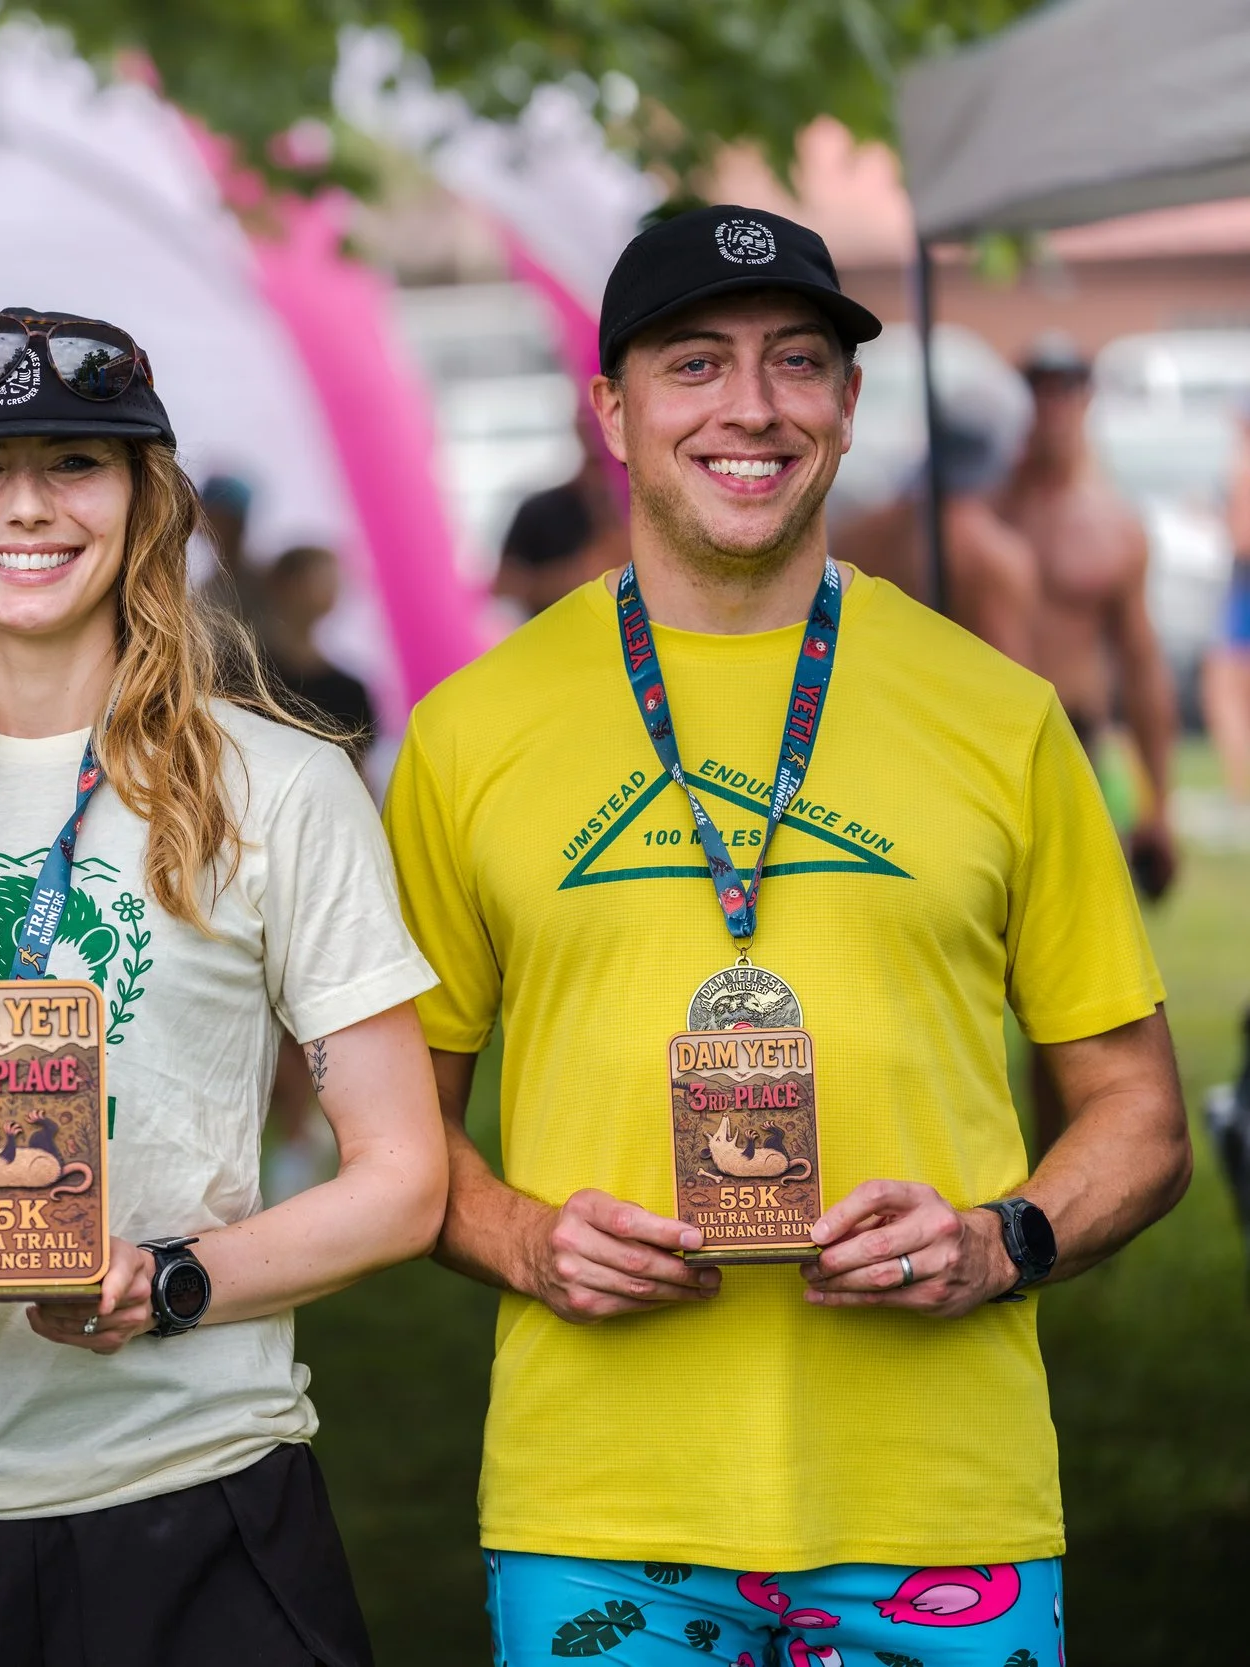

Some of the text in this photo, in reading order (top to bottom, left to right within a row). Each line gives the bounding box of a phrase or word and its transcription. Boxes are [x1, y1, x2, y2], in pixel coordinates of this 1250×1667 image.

[715, 222, 728, 238] BURY
[749, 220, 774, 238] BONES
[718, 245, 743, 264] VIRGINIA
[746, 253, 777, 265] CREEPER
[26, 348, 41, 367] ONES
[6, 387, 39, 405] CREEPER
[32, 368, 41, 386] TRAIL
[623, 608, 653, 674] YETI
[789, 684, 822, 745] YETI
[772, 767, 791, 819] RUNNERS
[562, 759, 895, 862] UMSTEAD ENDURNCE RUN
[642, 829, 762, 848] 100 MLES
[26, 888, 55, 938] TRAIL
[39, 891, 66, 946] RUNNERS
[701, 969, 785, 999] DAM YETI 55K
[727, 982, 770, 995] FINISHER
[3, 997, 91, 1038] YETI
[676, 1038, 807, 1072] DAM YETI
[689, 1082, 799, 1111] 3RD PLACE
[719, 1185, 782, 1210] 55K
[697, 1209, 803, 1225] ULTRA TRAIL
[698, 1223, 814, 1239] NDURANCE RUN
[12, 1232, 79, 1251] TRAIL
[49, 1251, 93, 1269] RUN
